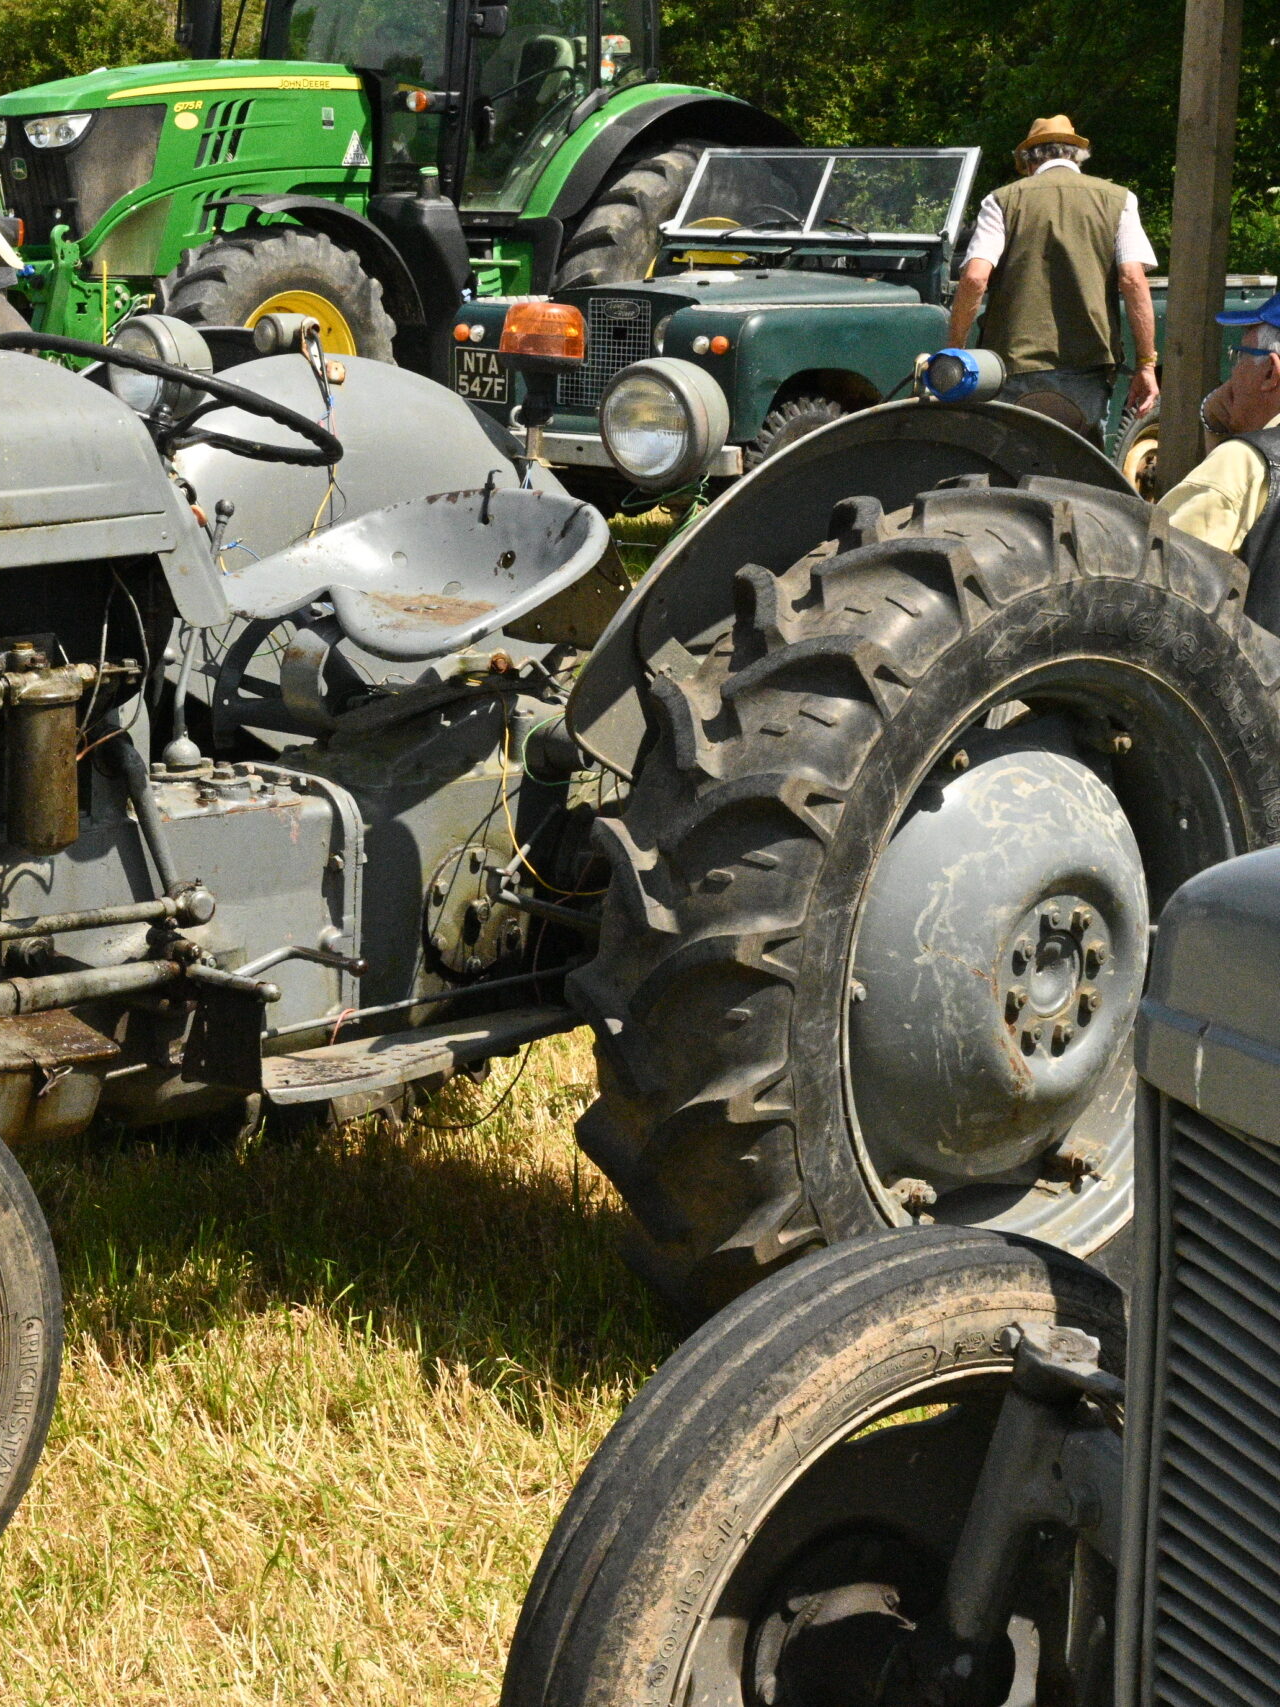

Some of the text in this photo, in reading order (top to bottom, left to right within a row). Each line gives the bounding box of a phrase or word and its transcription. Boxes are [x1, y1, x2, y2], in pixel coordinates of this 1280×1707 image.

[279, 79, 330, 88] JOHN DEERE
[463, 351, 499, 375] NTA
[458, 374, 505, 399] 547F
